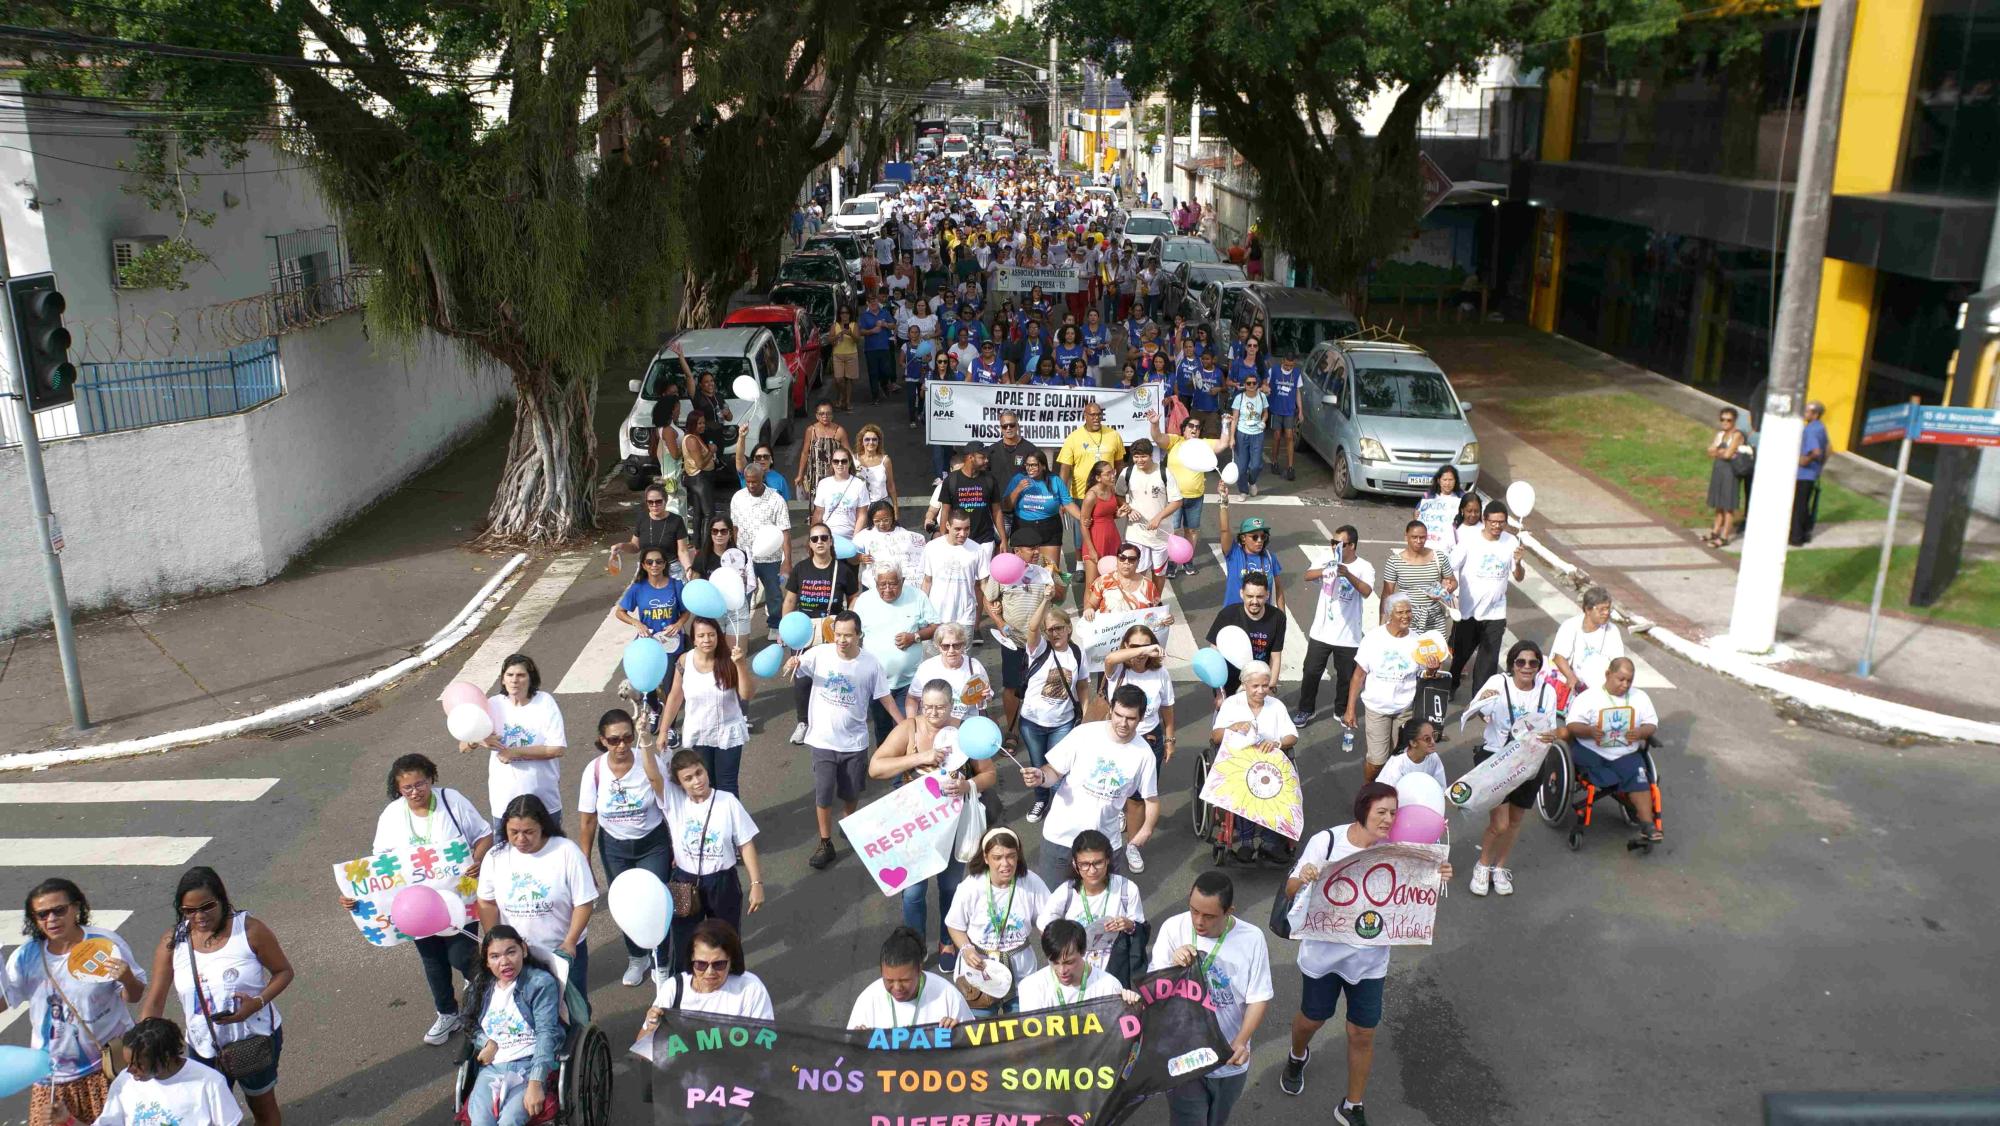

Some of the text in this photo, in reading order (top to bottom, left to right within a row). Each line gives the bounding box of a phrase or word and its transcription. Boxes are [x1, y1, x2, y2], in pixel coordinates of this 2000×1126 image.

[995, 390, 1096, 408] APAE DE COLATINA
[933, 410, 955, 418] APAE
[1039, 410, 1054, 422] NA
[1058, 410, 1086, 422] FEST
[965, 424, 1003, 438] “NOSS
[1019, 425, 1061, 439] ENHORA
[800, 595, 838, 603] dignidae
[651, 608, 673, 620] APAE
[1490, 743, 1520, 768] RESPEITO
[864, 798, 962, 858] RESPEITO
[351, 866, 460, 897] NADA SOBRE
[666, 1027, 778, 1057] AMOR
[867, 1013, 1104, 1050] APAE VITORIA
[877, 1069, 989, 1093] TODOS
[1001, 1067, 1115, 1091] SOMOS
[686, 1085, 755, 1109] PAZ
